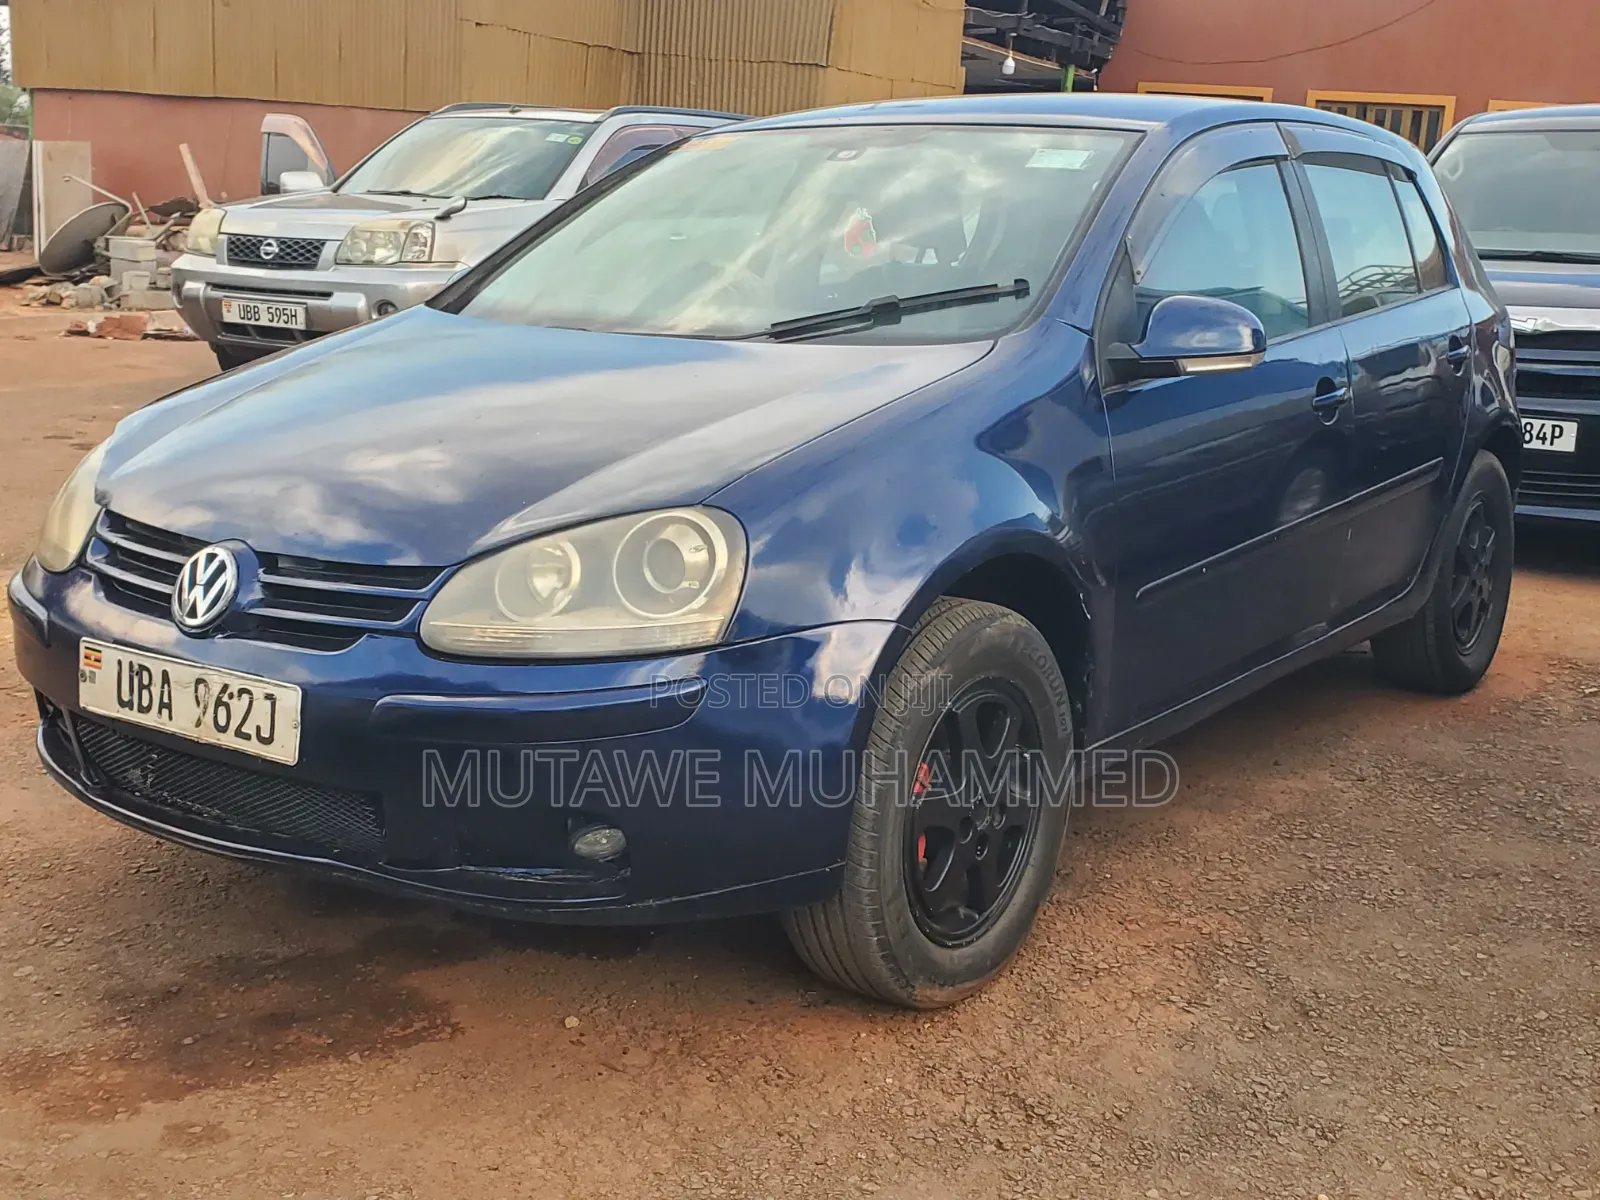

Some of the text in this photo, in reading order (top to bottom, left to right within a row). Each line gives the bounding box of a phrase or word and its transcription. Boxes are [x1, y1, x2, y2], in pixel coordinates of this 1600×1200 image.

[237, 303, 298, 326] UBB 595H
[1523, 421, 1564, 447] 84P
[117, 658, 277, 745] UBA 962J
